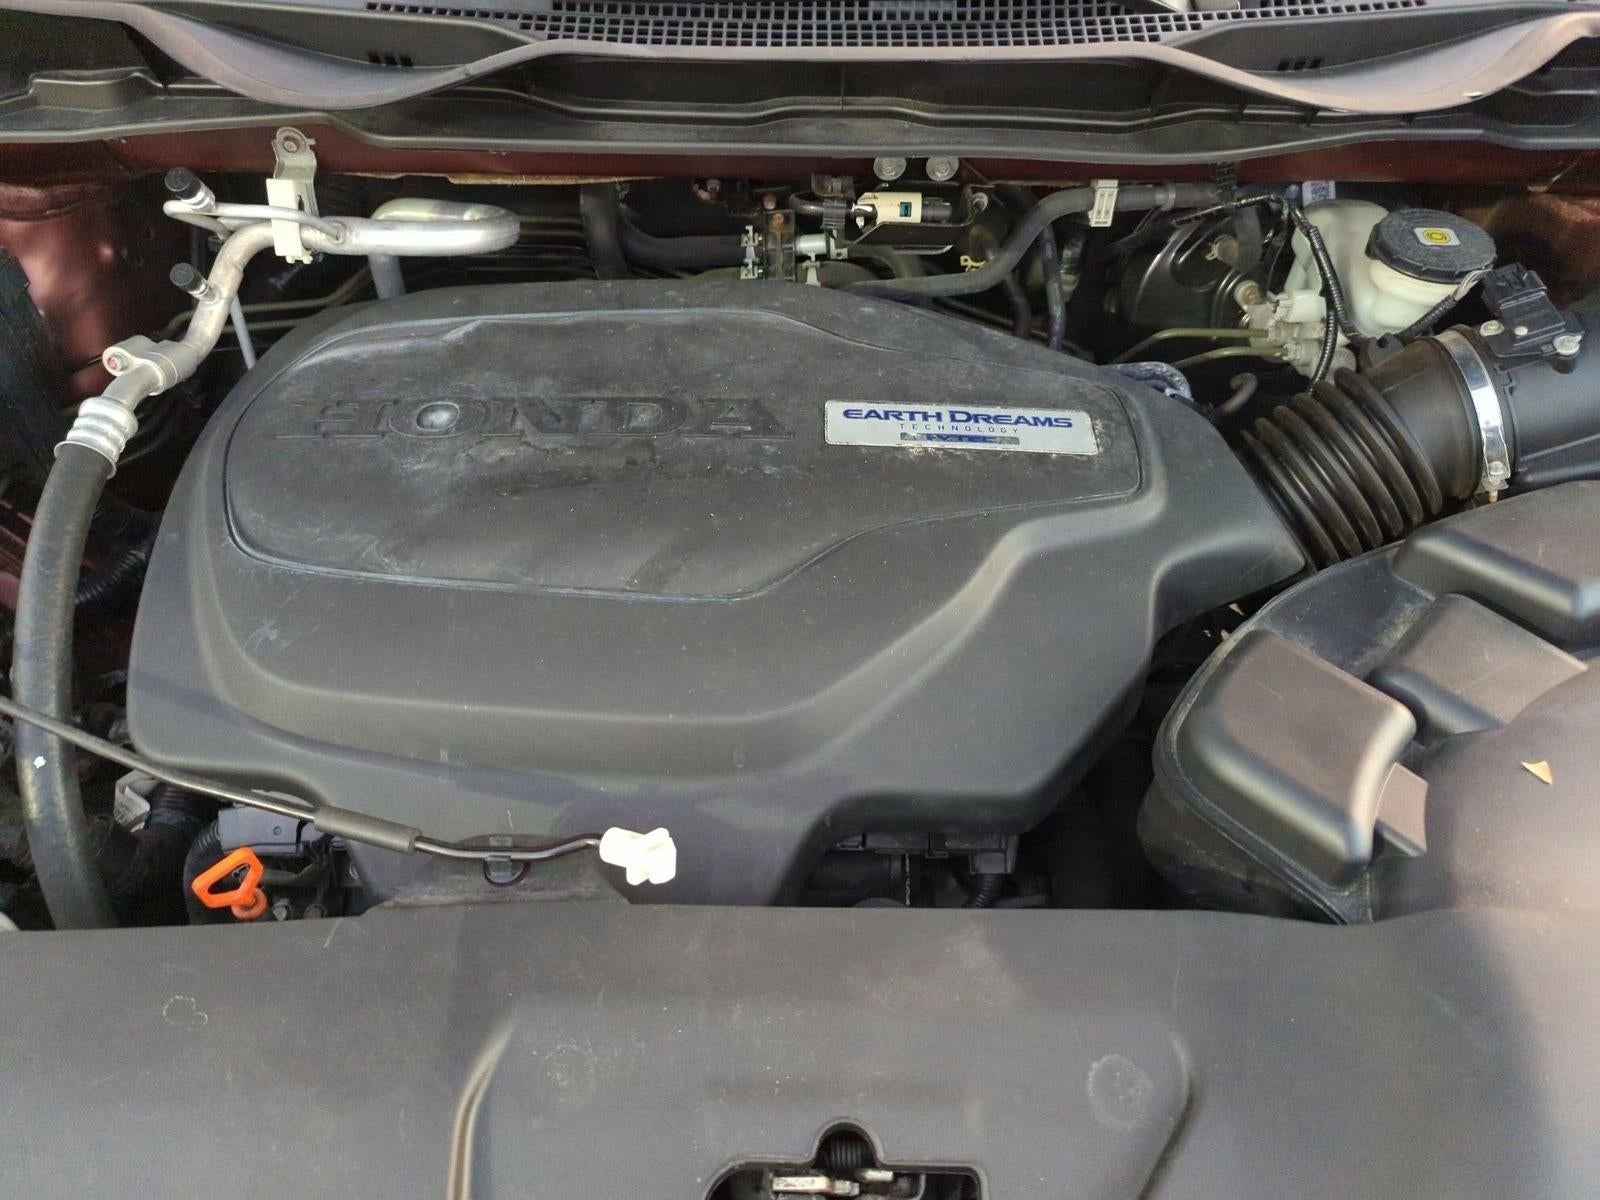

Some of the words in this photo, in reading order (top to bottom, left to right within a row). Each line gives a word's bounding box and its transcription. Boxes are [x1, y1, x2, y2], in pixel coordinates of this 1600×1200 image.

[273, 398, 795, 438] HONDA
[842, 408, 942, 422] EARTH
[949, 410, 1073, 428] DREAMS
[899, 423, 1019, 433] TECHNOLOGY
